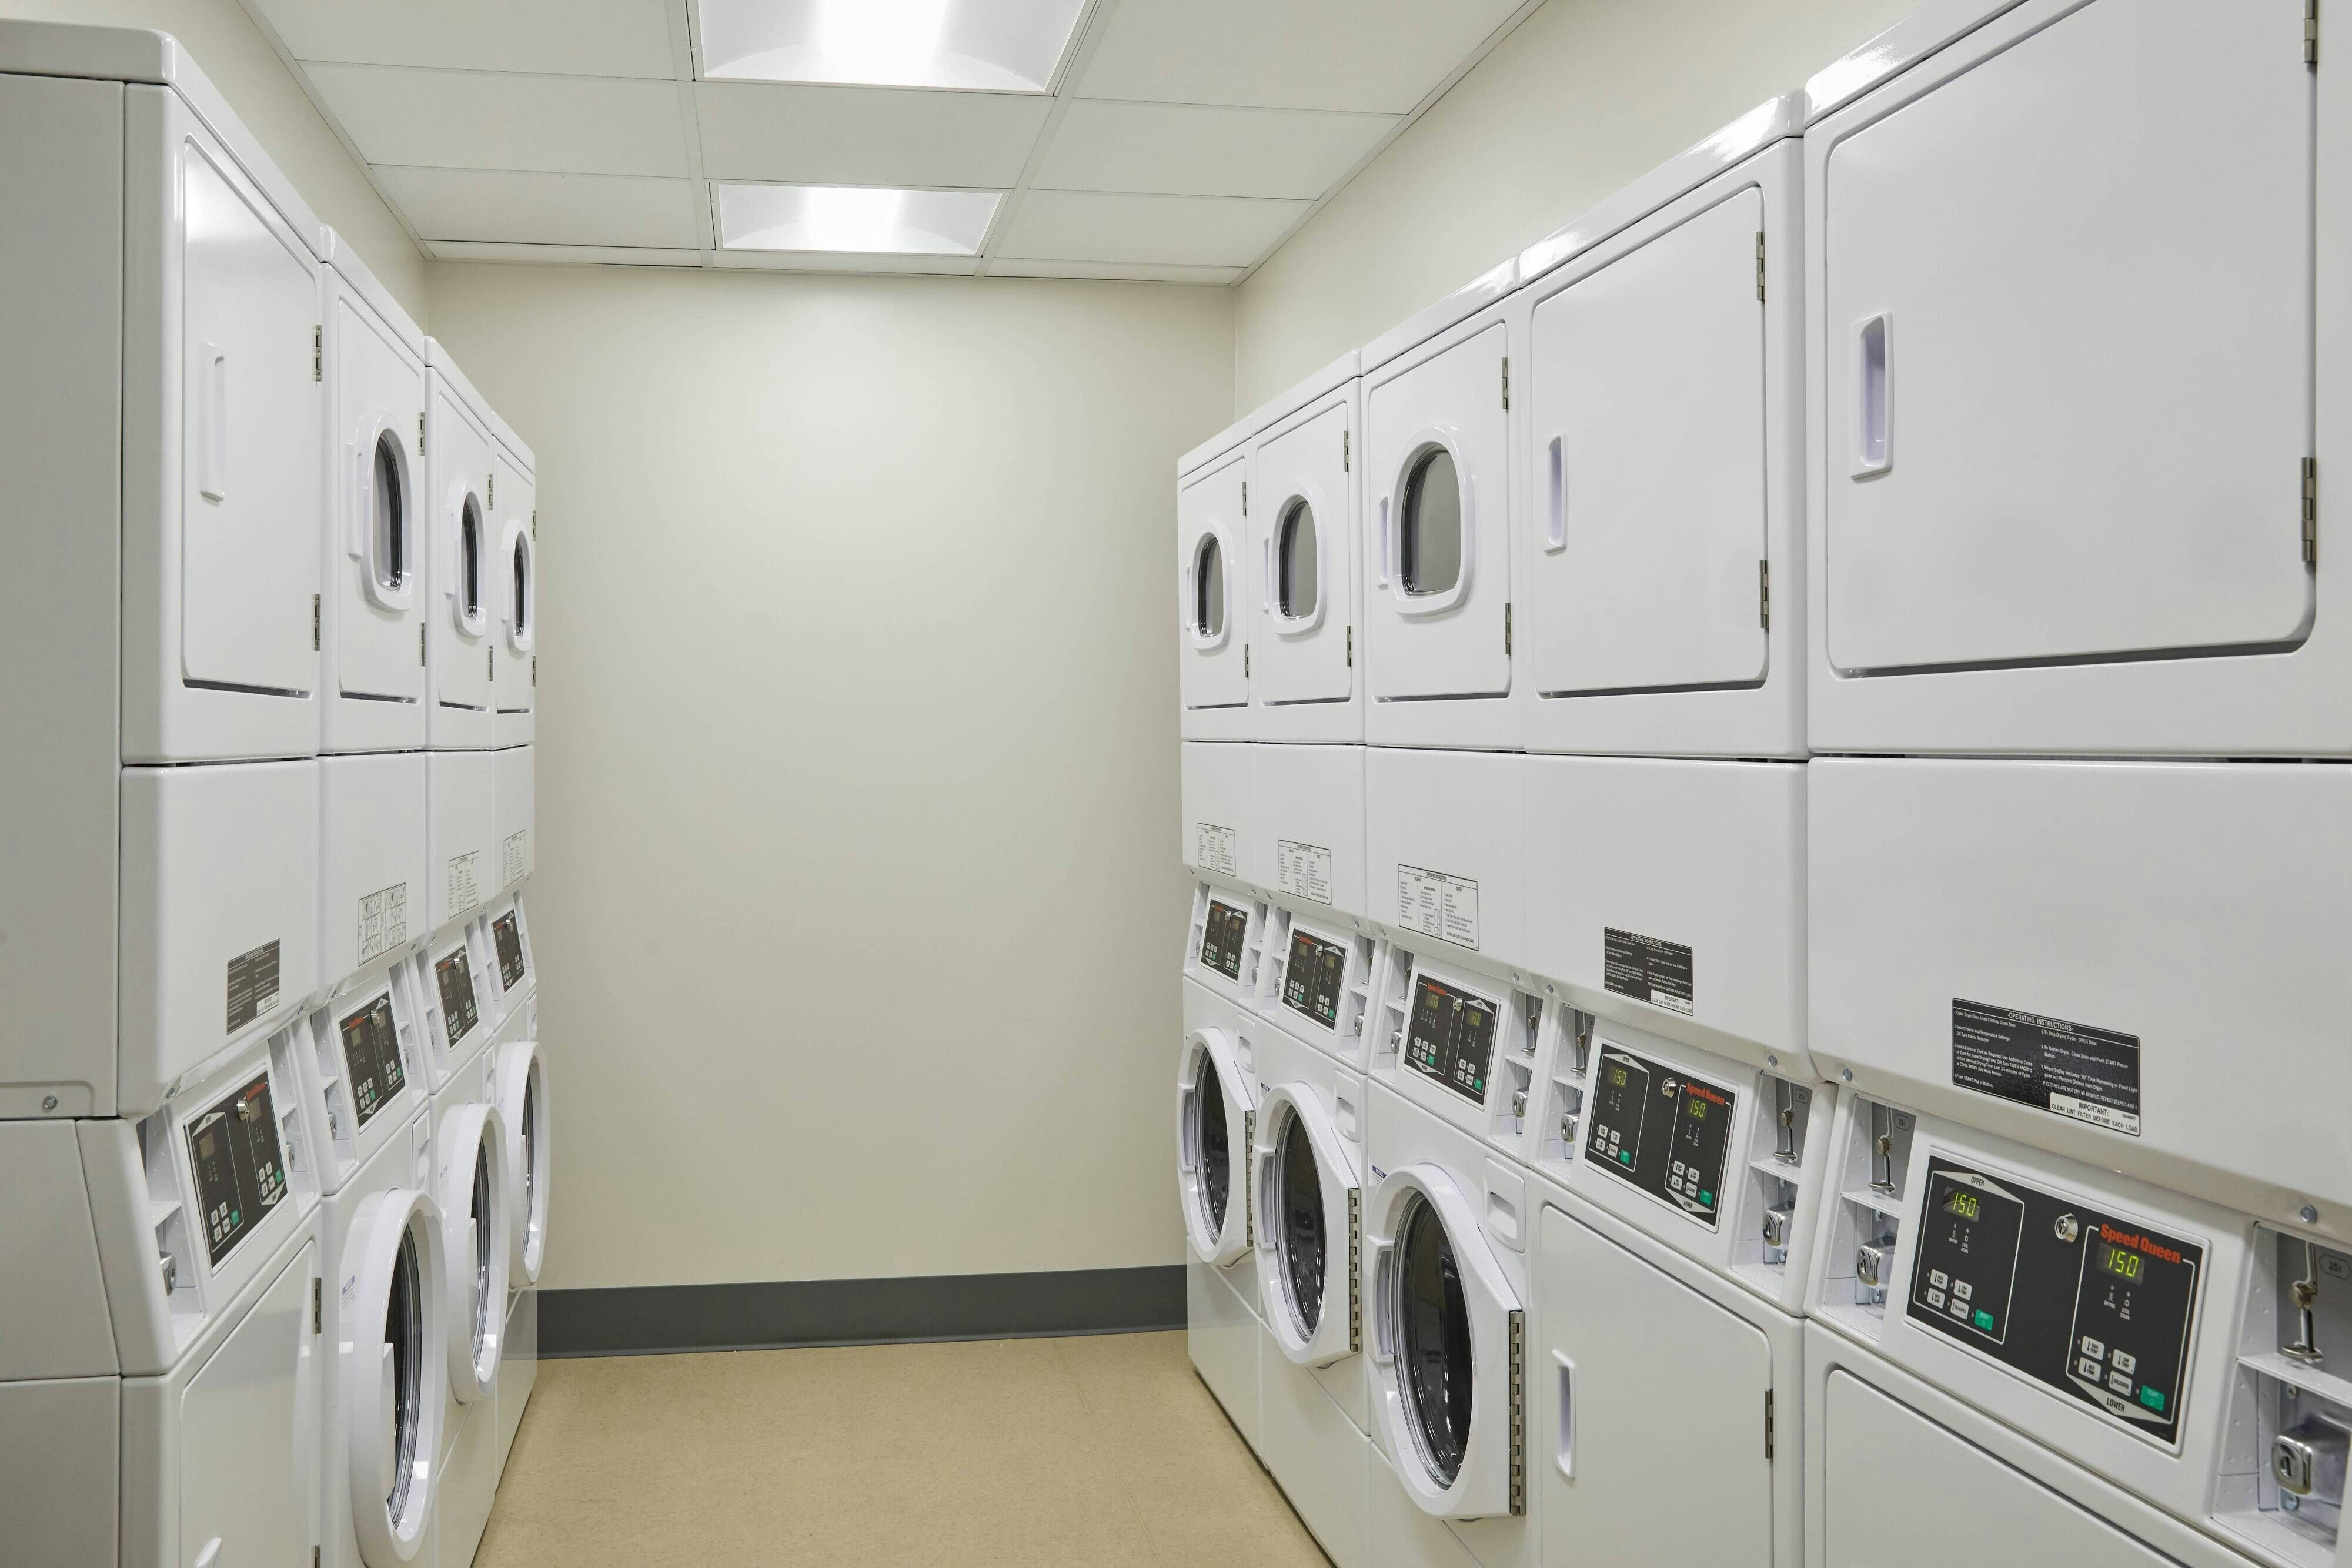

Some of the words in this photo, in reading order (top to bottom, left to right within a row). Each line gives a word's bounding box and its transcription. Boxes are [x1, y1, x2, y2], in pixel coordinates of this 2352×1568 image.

[1614, 1069, 1627, 1086] 150
[1686, 1082, 1705, 1098] Speed
[1705, 1089, 1725, 1105] Queen
[1690, 1099, 1705, 1117] 150
[2079, 1102, 2109, 1116] IMPORTANT:
[2052, 1104, 2065, 1112] CLEAN
[2077, 1111, 2092, 1119] FILTER
[2093, 1115, 2110, 1125] BEFORE
[2112, 1120, 2124, 1129] EACH
[2126, 1124, 2138, 1132] LOAD
[1971, 1176, 1984, 1186] UPPER
[1953, 1192, 1976, 1216] 150
[2100, 1223, 2139, 1249] Speed
[2140, 1236, 2181, 1265] Queen
[2108, 1249, 2139, 1277] 150
[2114, 1379, 2129, 1389] DELICATES
[2107, 1397, 2125, 1412] LOWER
